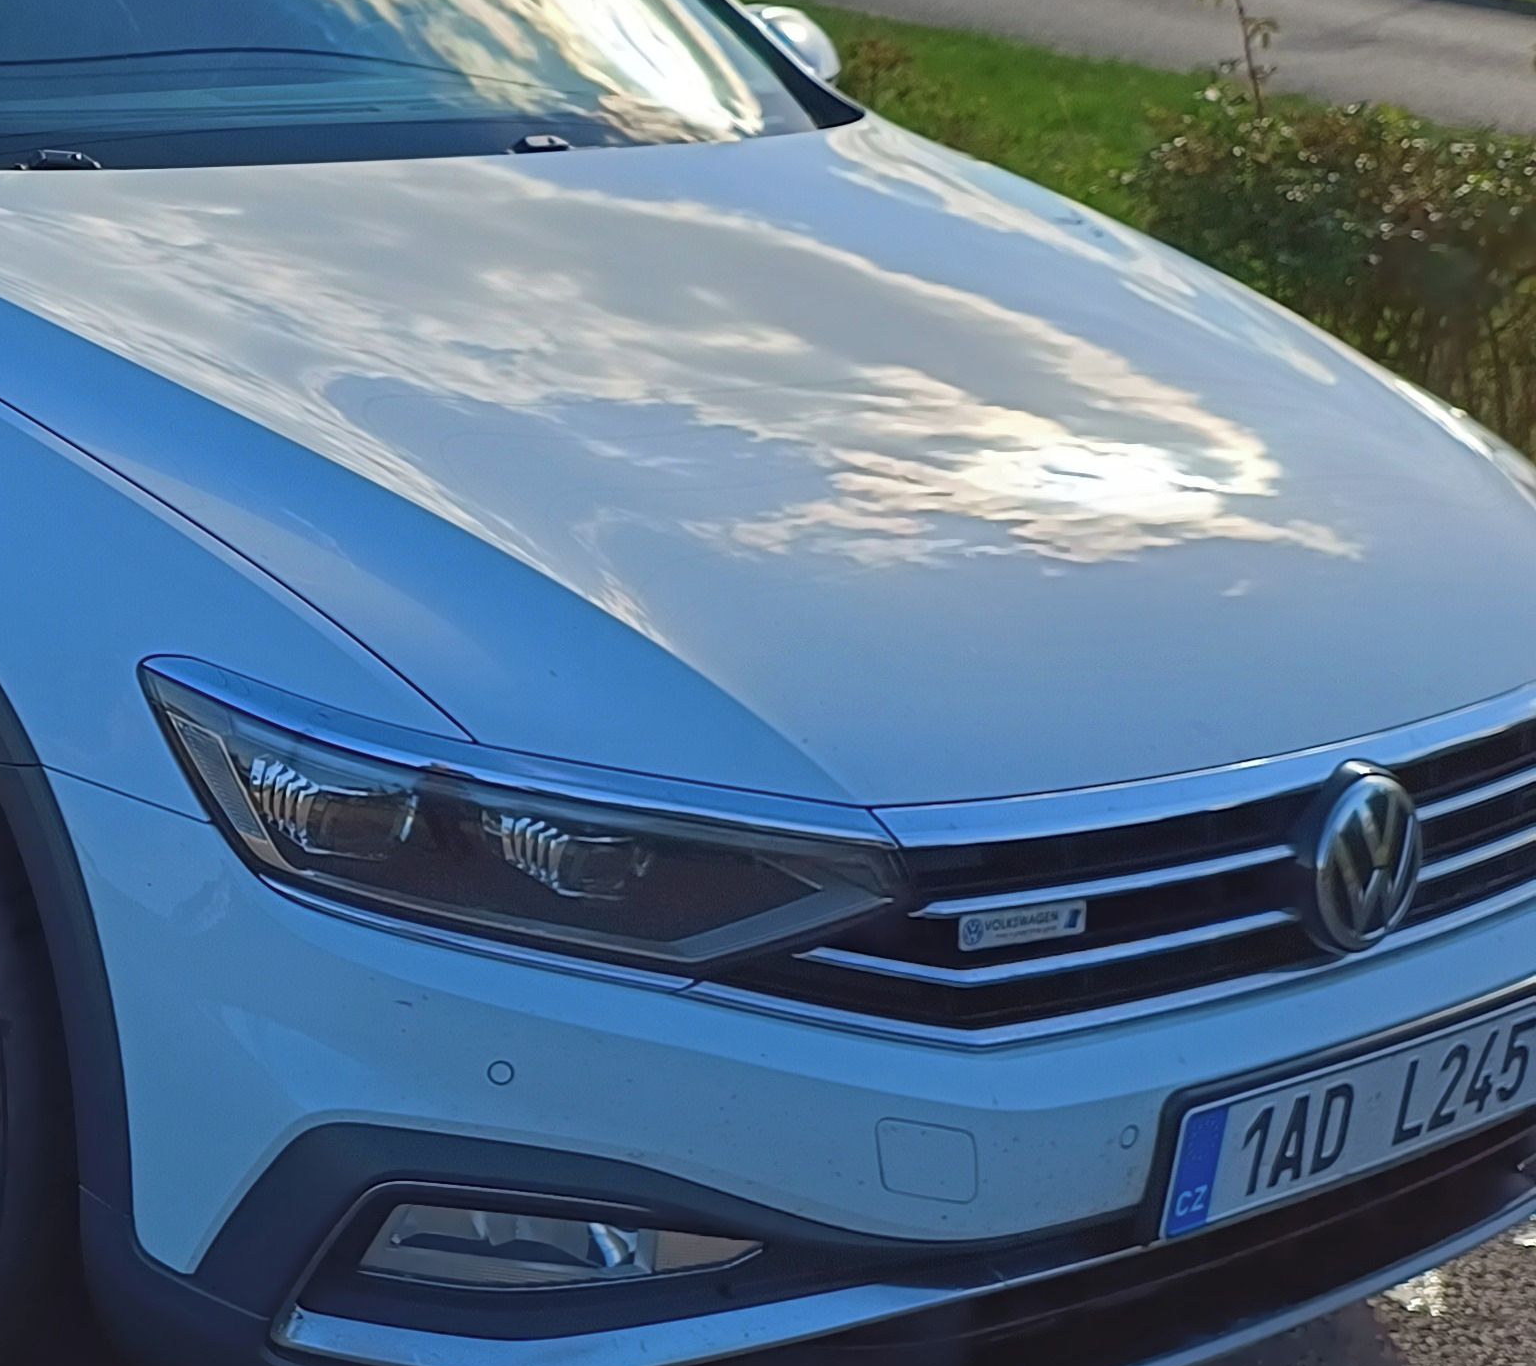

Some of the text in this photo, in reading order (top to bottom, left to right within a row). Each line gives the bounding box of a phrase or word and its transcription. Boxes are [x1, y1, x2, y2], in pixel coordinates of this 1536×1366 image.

[984, 910, 1059, 932] VOLKSWAGEN
[1241, 1017, 1536, 1197] 1AD L245
[1175, 1185, 1208, 1216] CZ
